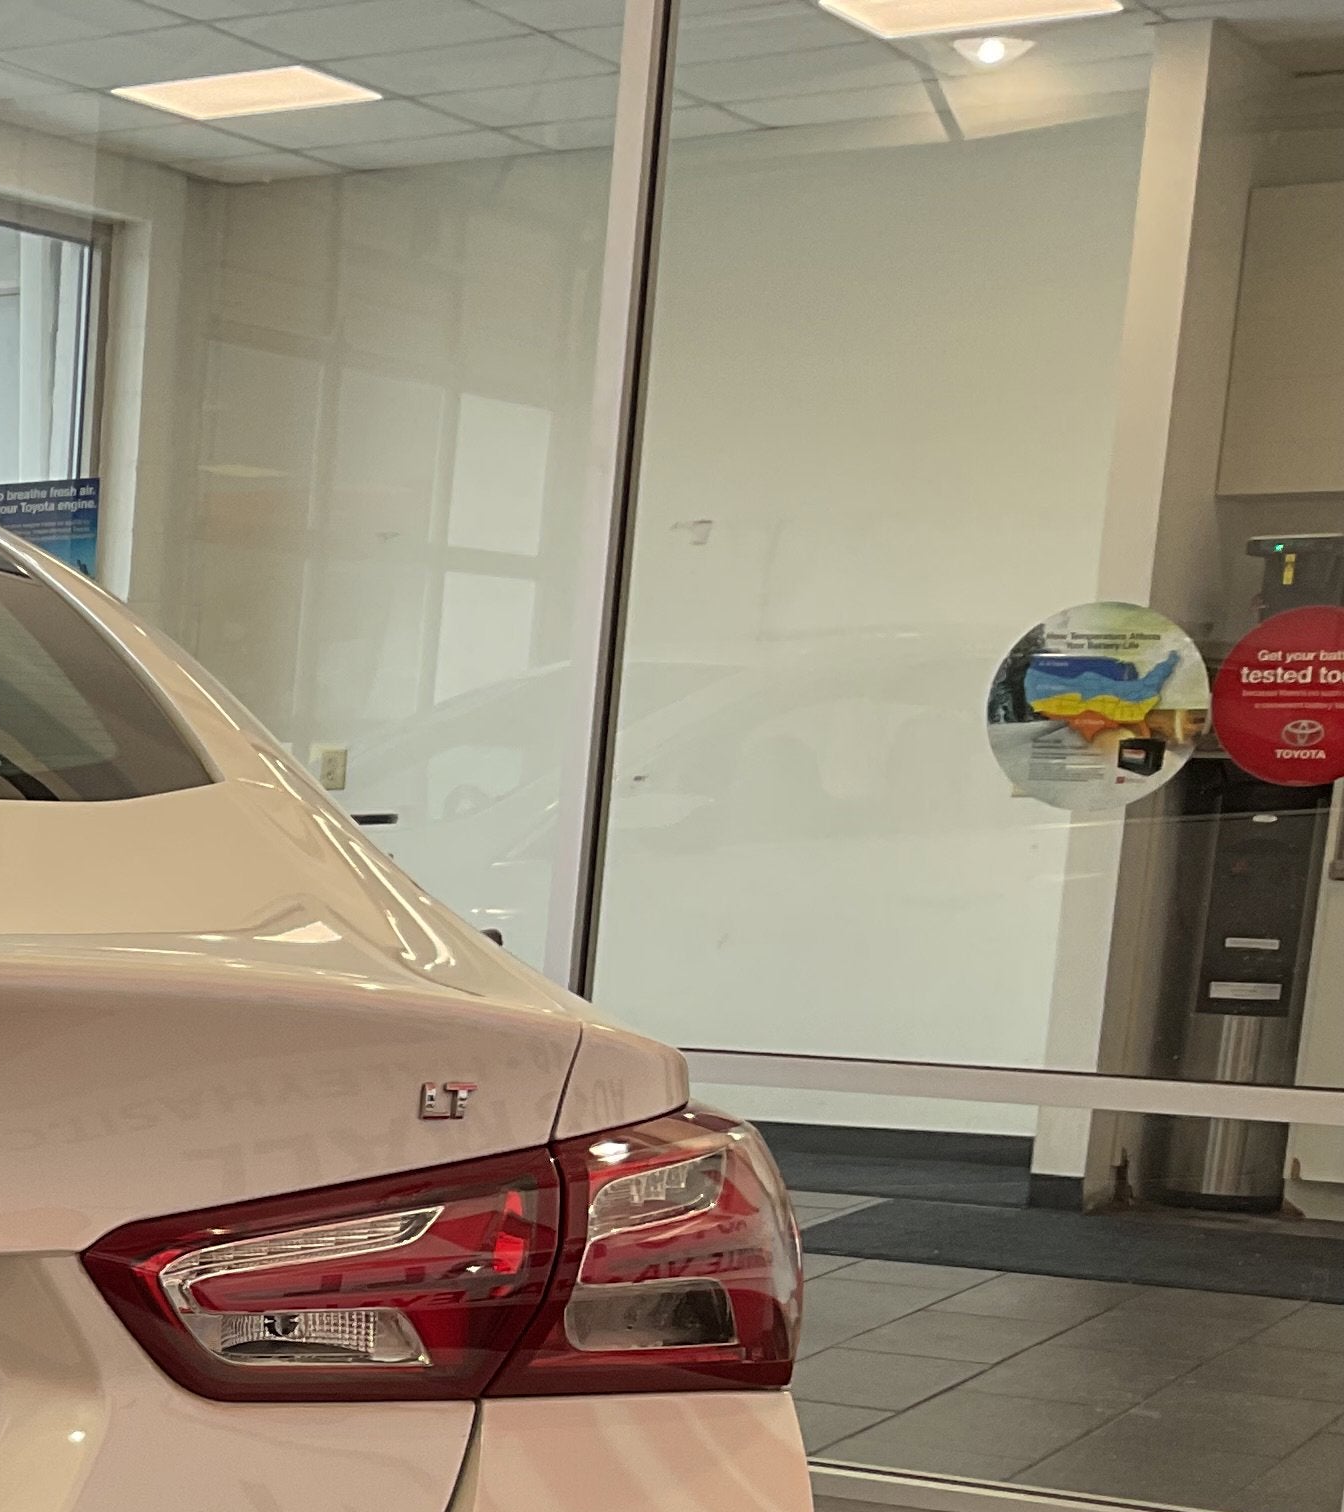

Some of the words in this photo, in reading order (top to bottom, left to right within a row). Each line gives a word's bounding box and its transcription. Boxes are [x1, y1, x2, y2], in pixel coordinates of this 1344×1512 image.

[7, 488, 47, 501] breathe
[50, 486, 76, 498] fresh
[79, 485, 96, 496] air.
[20, 501, 55, 515] Toyota
[58, 499, 97, 512] engine.
[1257, 649, 1283, 661] Get
[1285, 651, 1316, 663] your
[1240, 666, 1313, 683] tested
[1319, 666, 1344, 683] to
[1275, 749, 1326, 760] TOYOTA
[418, 1081, 479, 1120] LT
